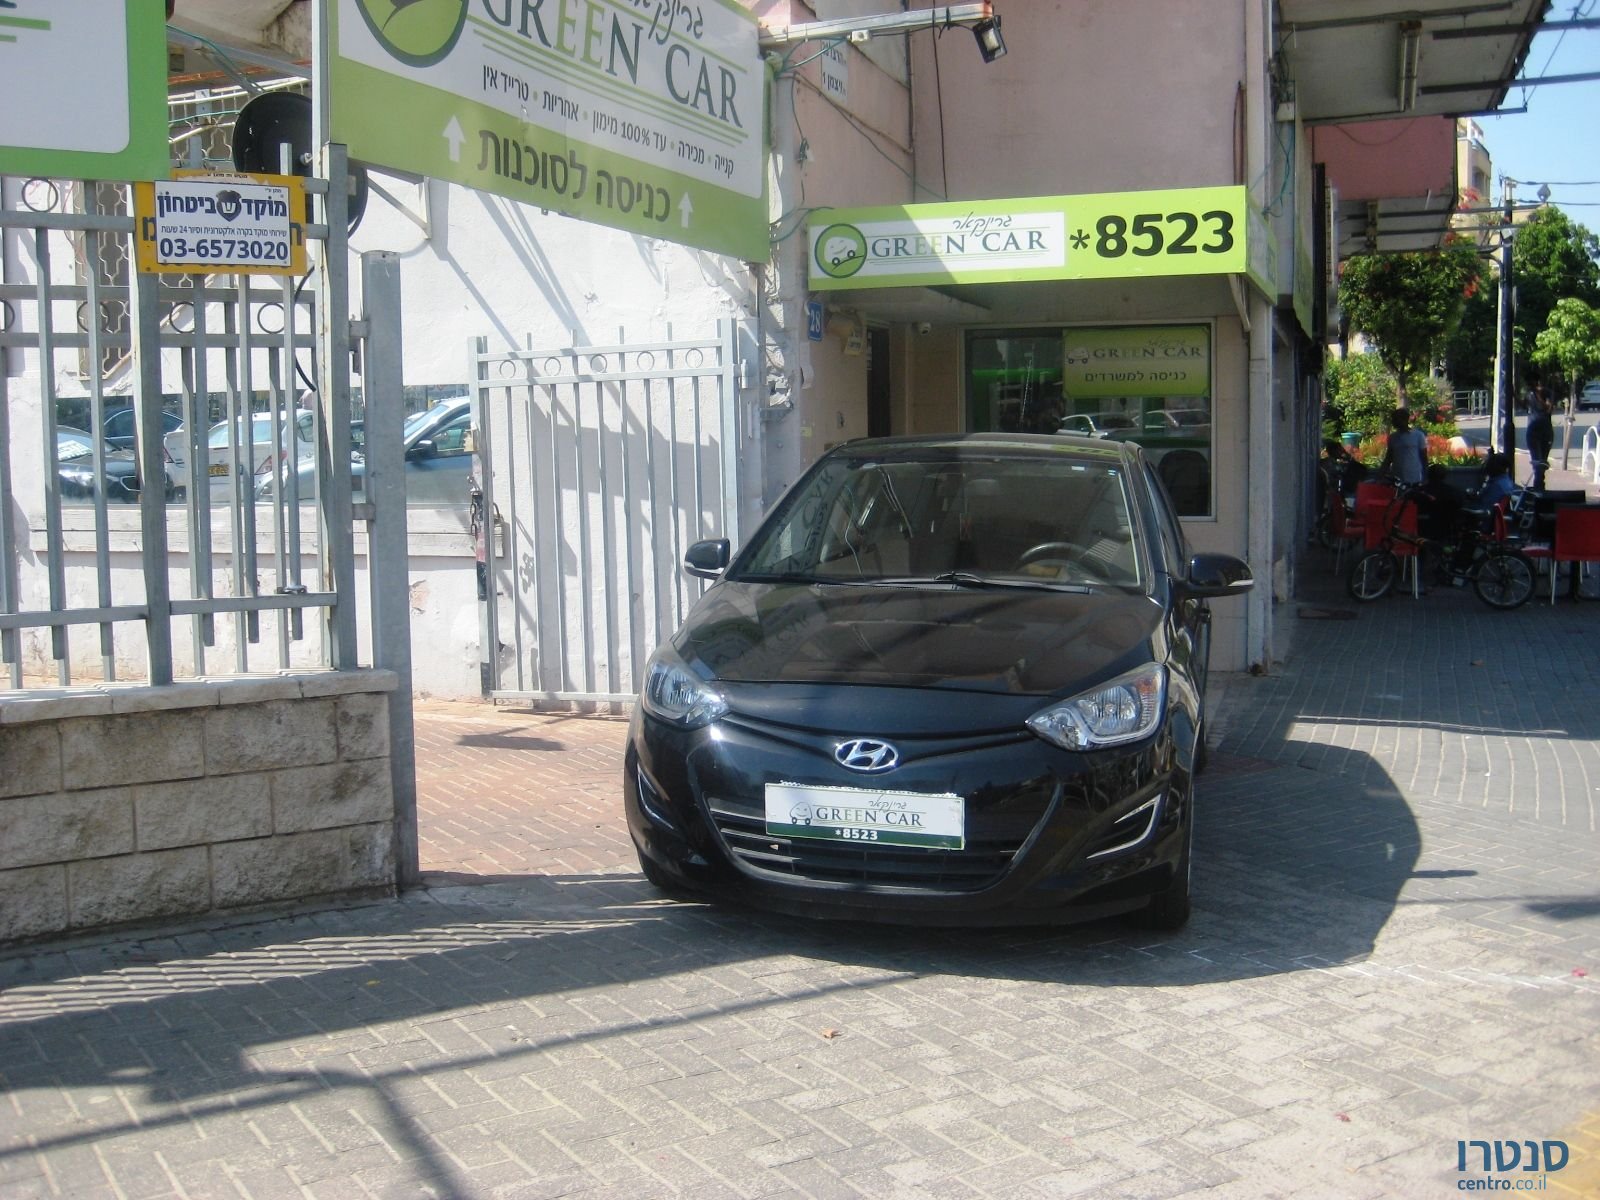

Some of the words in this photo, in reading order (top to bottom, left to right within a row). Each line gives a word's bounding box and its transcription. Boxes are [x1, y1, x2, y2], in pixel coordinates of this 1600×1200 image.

[483, 65, 498, 91] אין
[500, 71, 529, 102] טרייד
[665, 43, 743, 128] CAR
[542, 90, 579, 122] אחריות
[592, 110, 618, 135] מימון
[621, 121, 650, 147] 100%
[653, 131, 667, 152] עד
[678, 140, 705, 165] מכירה
[477, 129, 588, 200] לסוכנות
[714, 154, 734, 179] קנייה
[596, 169, 671, 223] כניסה
[179, 225, 188, 233] 24
[160, 237, 289, 260] 03-6573020
[871, 235, 966, 257] GREEN
[981, 230, 1048, 252] CAR
[809, 309, 821, 333] 28
[1093, 347, 1155, 359] GREEN
[1164, 346, 1202, 358] CAR
[1085, 370, 1145, 382] למשרדים
[1149, 370, 1187, 381] כניסה
[816, 807, 878, 824] GREEN
[885, 811, 922, 827] CAR
